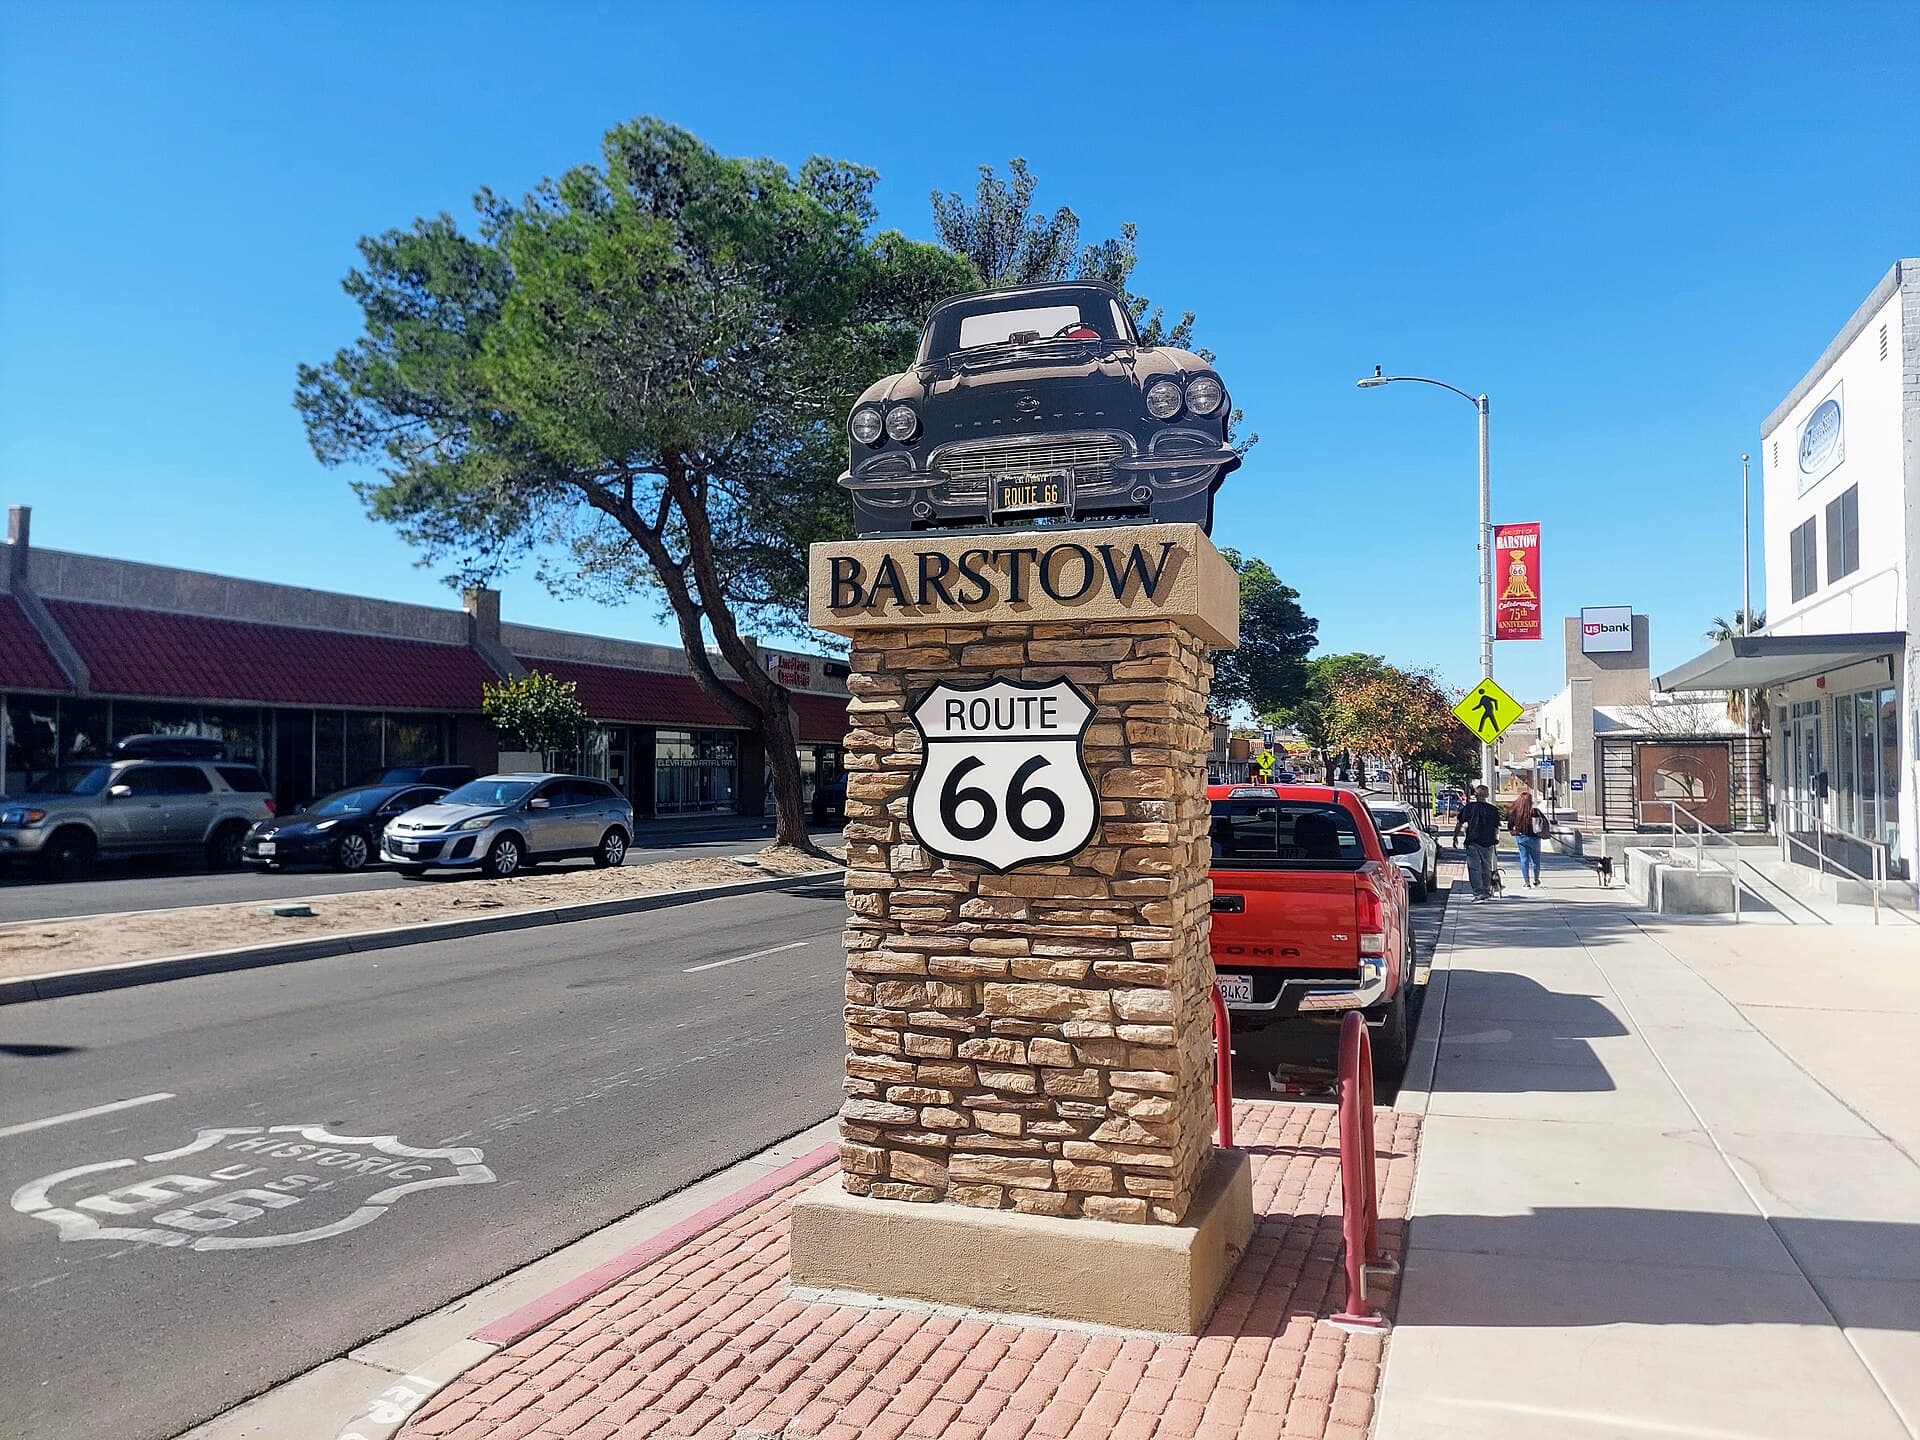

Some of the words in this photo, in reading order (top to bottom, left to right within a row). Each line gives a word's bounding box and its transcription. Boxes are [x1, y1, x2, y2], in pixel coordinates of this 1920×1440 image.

[1004, 485, 1038, 506] ROUTE
[1044, 484, 1059, 503] 66
[1496, 534, 1537, 549] BARSTOW
[826, 541, 1177, 609] BARSTOW
[1509, 608, 1528, 621] 75th
[945, 696, 1058, 731] ROUTE
[657, 759, 692, 767] ELEVATED
[939, 755, 1065, 842] 66
[1225, 945, 1300, 957] OMA
[1220, 985, 1249, 999] 84K2
[227, 1137, 432, 1180] HISTORIC
[75, 1174, 302, 1231] 66
